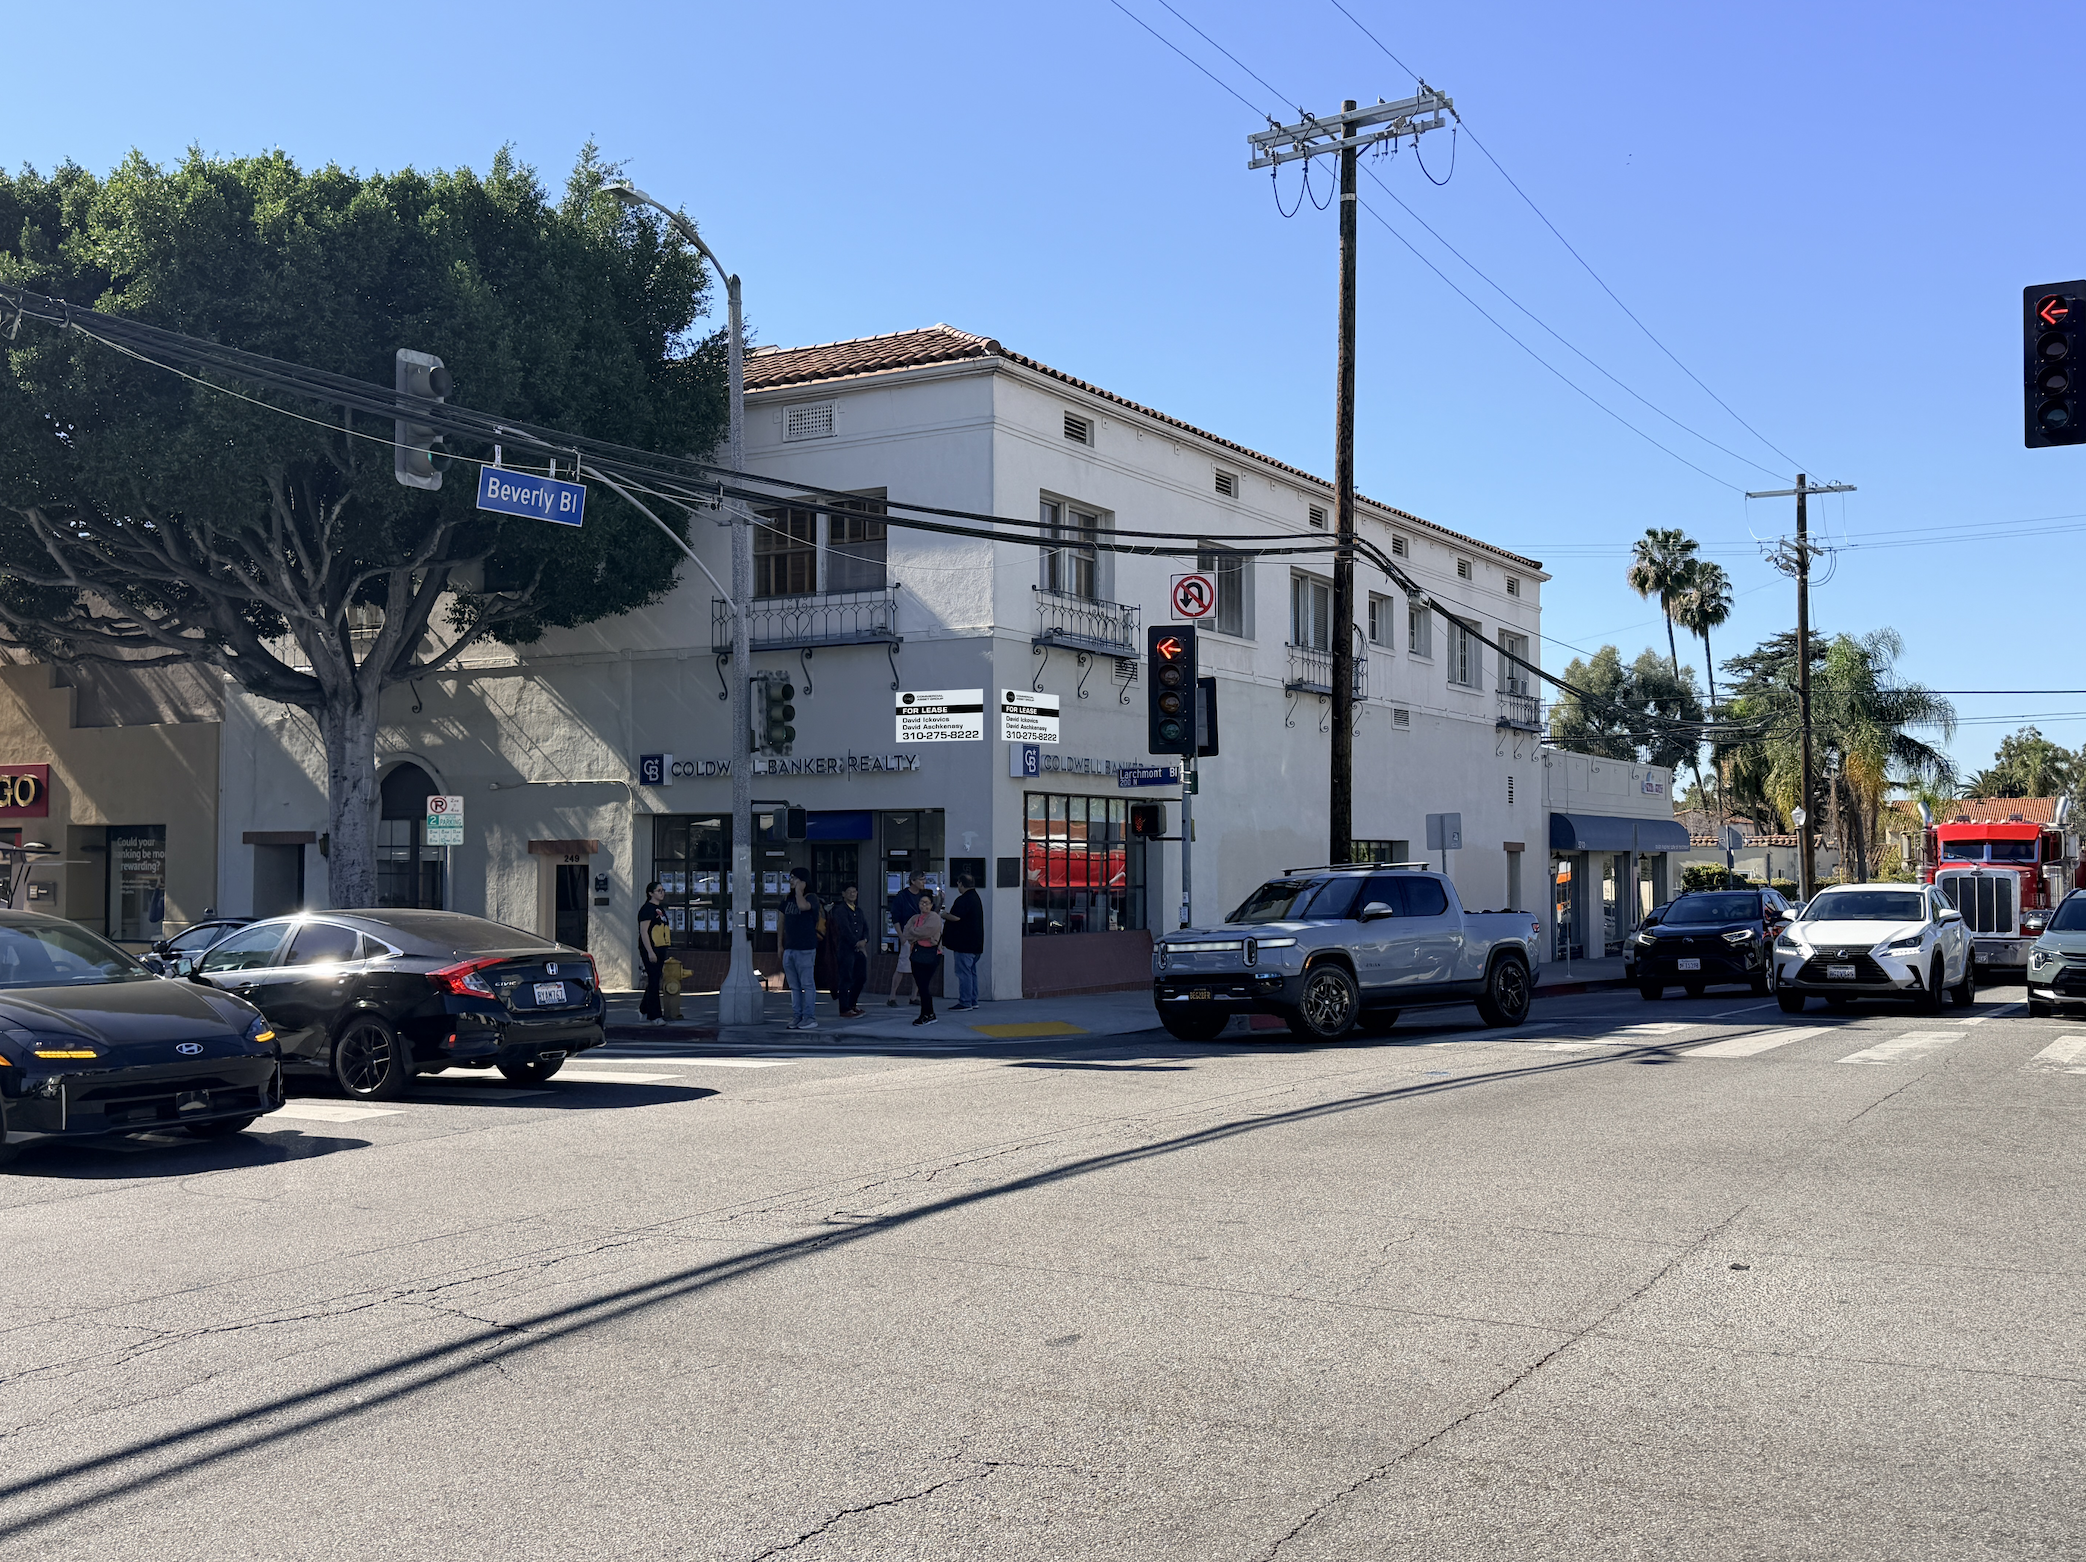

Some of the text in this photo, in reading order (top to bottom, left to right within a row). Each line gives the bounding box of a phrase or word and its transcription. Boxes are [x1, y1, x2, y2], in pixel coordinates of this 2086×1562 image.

[487, 476, 578, 514] Beverly Bl
[921, 706, 948, 714] LEASE
[1005, 705, 1038, 715] FOR LEASE
[902, 730, 979, 740] 310-275-8222
[1005, 730, 1057, 741] 310-275-8222
[671, 754, 917, 777] COLDWL BANKER REALTY
[1044, 755, 1102, 774] COLDWELL
[1120, 767, 1178, 780] Larchmont Bl
[429, 815, 437, 825] 2
[440, 818, 462, 826] PARKING
[117, 836, 156, 849] Could your
[142, 848, 152, 859] be
[152, 850, 166, 859] mo
[564, 854, 580, 863] 249
[120, 860, 161, 873] rewarding?
